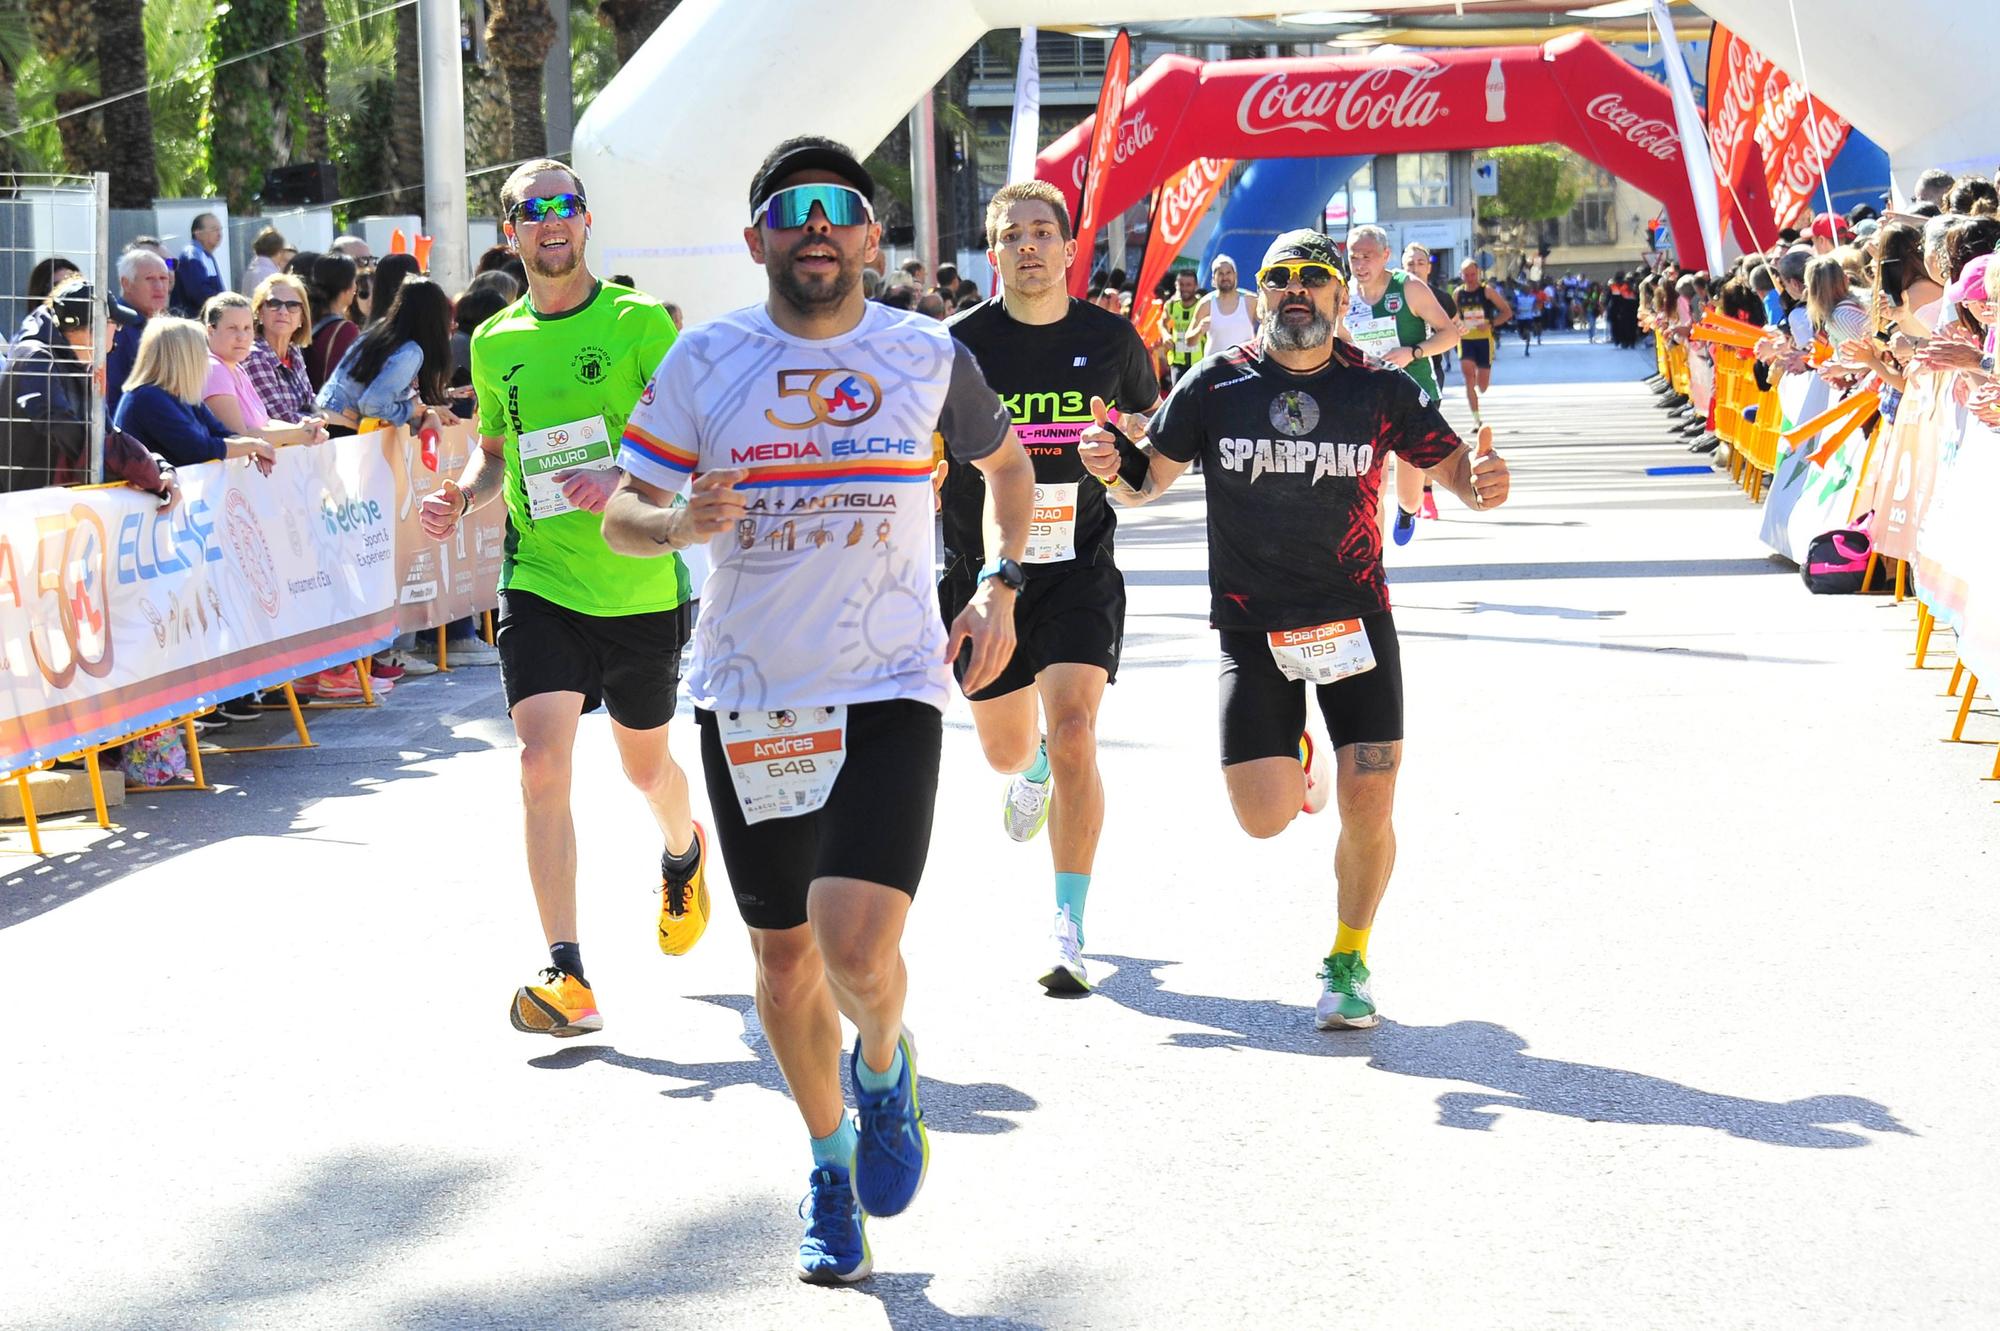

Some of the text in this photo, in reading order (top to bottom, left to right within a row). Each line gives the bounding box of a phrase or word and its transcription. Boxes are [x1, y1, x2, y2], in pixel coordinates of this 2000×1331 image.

[1237, 63, 1454, 135] Coca-Cola
[1586, 93, 1682, 161] Coca-Cola
[764, 368, 882, 430] 50
[538, 448, 588, 470] MAURO
[730, 437, 916, 464] MEDIA ELCHE
[1218, 437, 1375, 487] SPARPAKO
[791, 493, 898, 512] ANTIGUA
[117, 498, 224, 585] ELCHE
[1283, 622, 1346, 644] Sparpako
[1300, 641, 1337, 659] 1199
[754, 736, 815, 758] Andres
[767, 758, 817, 778] 648
